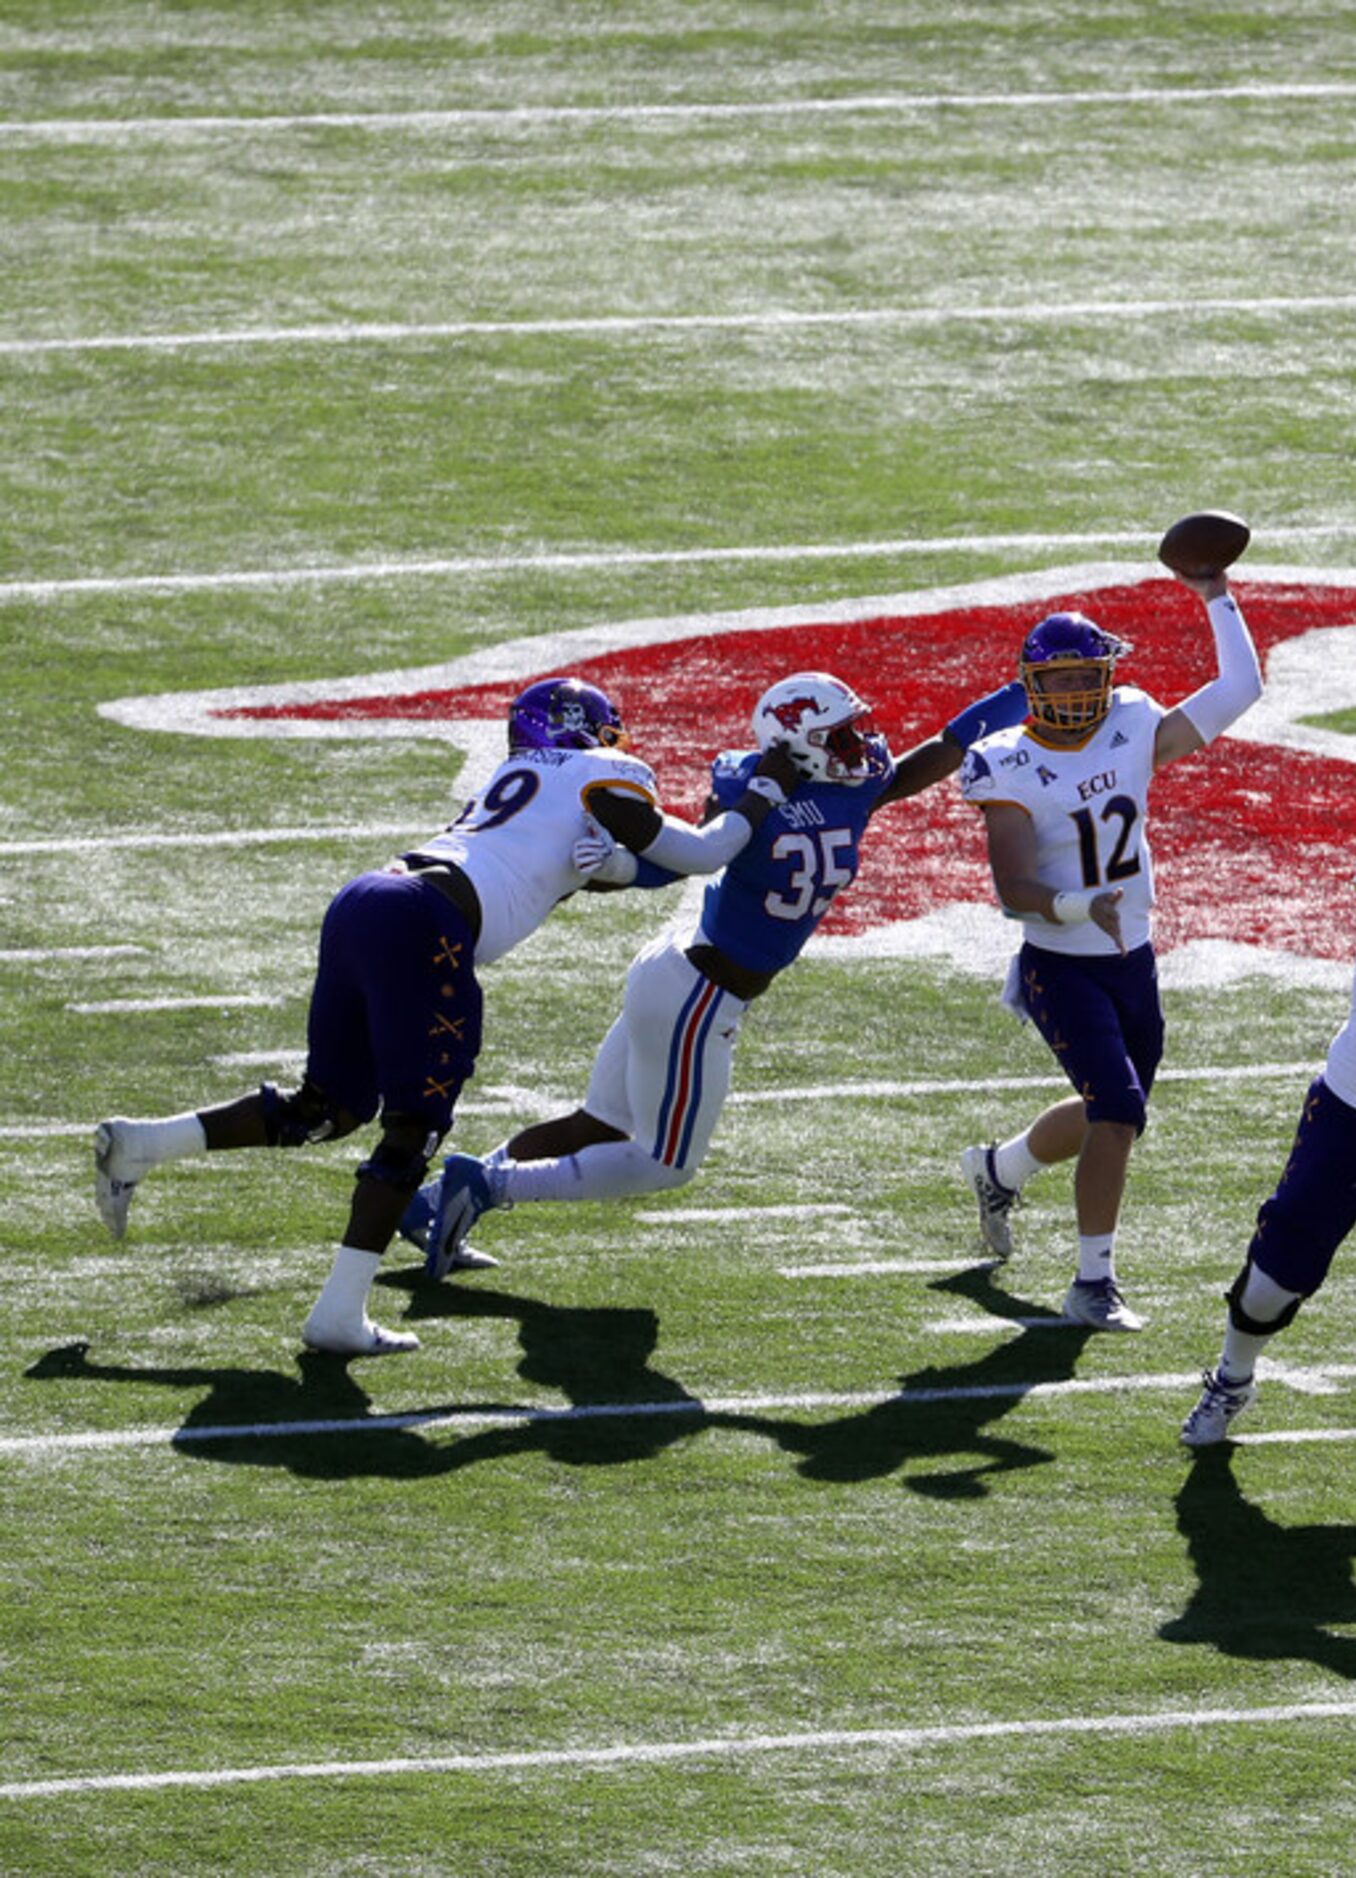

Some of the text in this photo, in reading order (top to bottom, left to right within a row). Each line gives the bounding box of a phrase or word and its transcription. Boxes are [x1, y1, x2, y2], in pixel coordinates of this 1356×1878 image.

[779, 799, 825, 829] SMU
[1077, 770, 1117, 801] ECU
[1069, 794, 1141, 889] 12
[764, 829, 852, 920] 35
